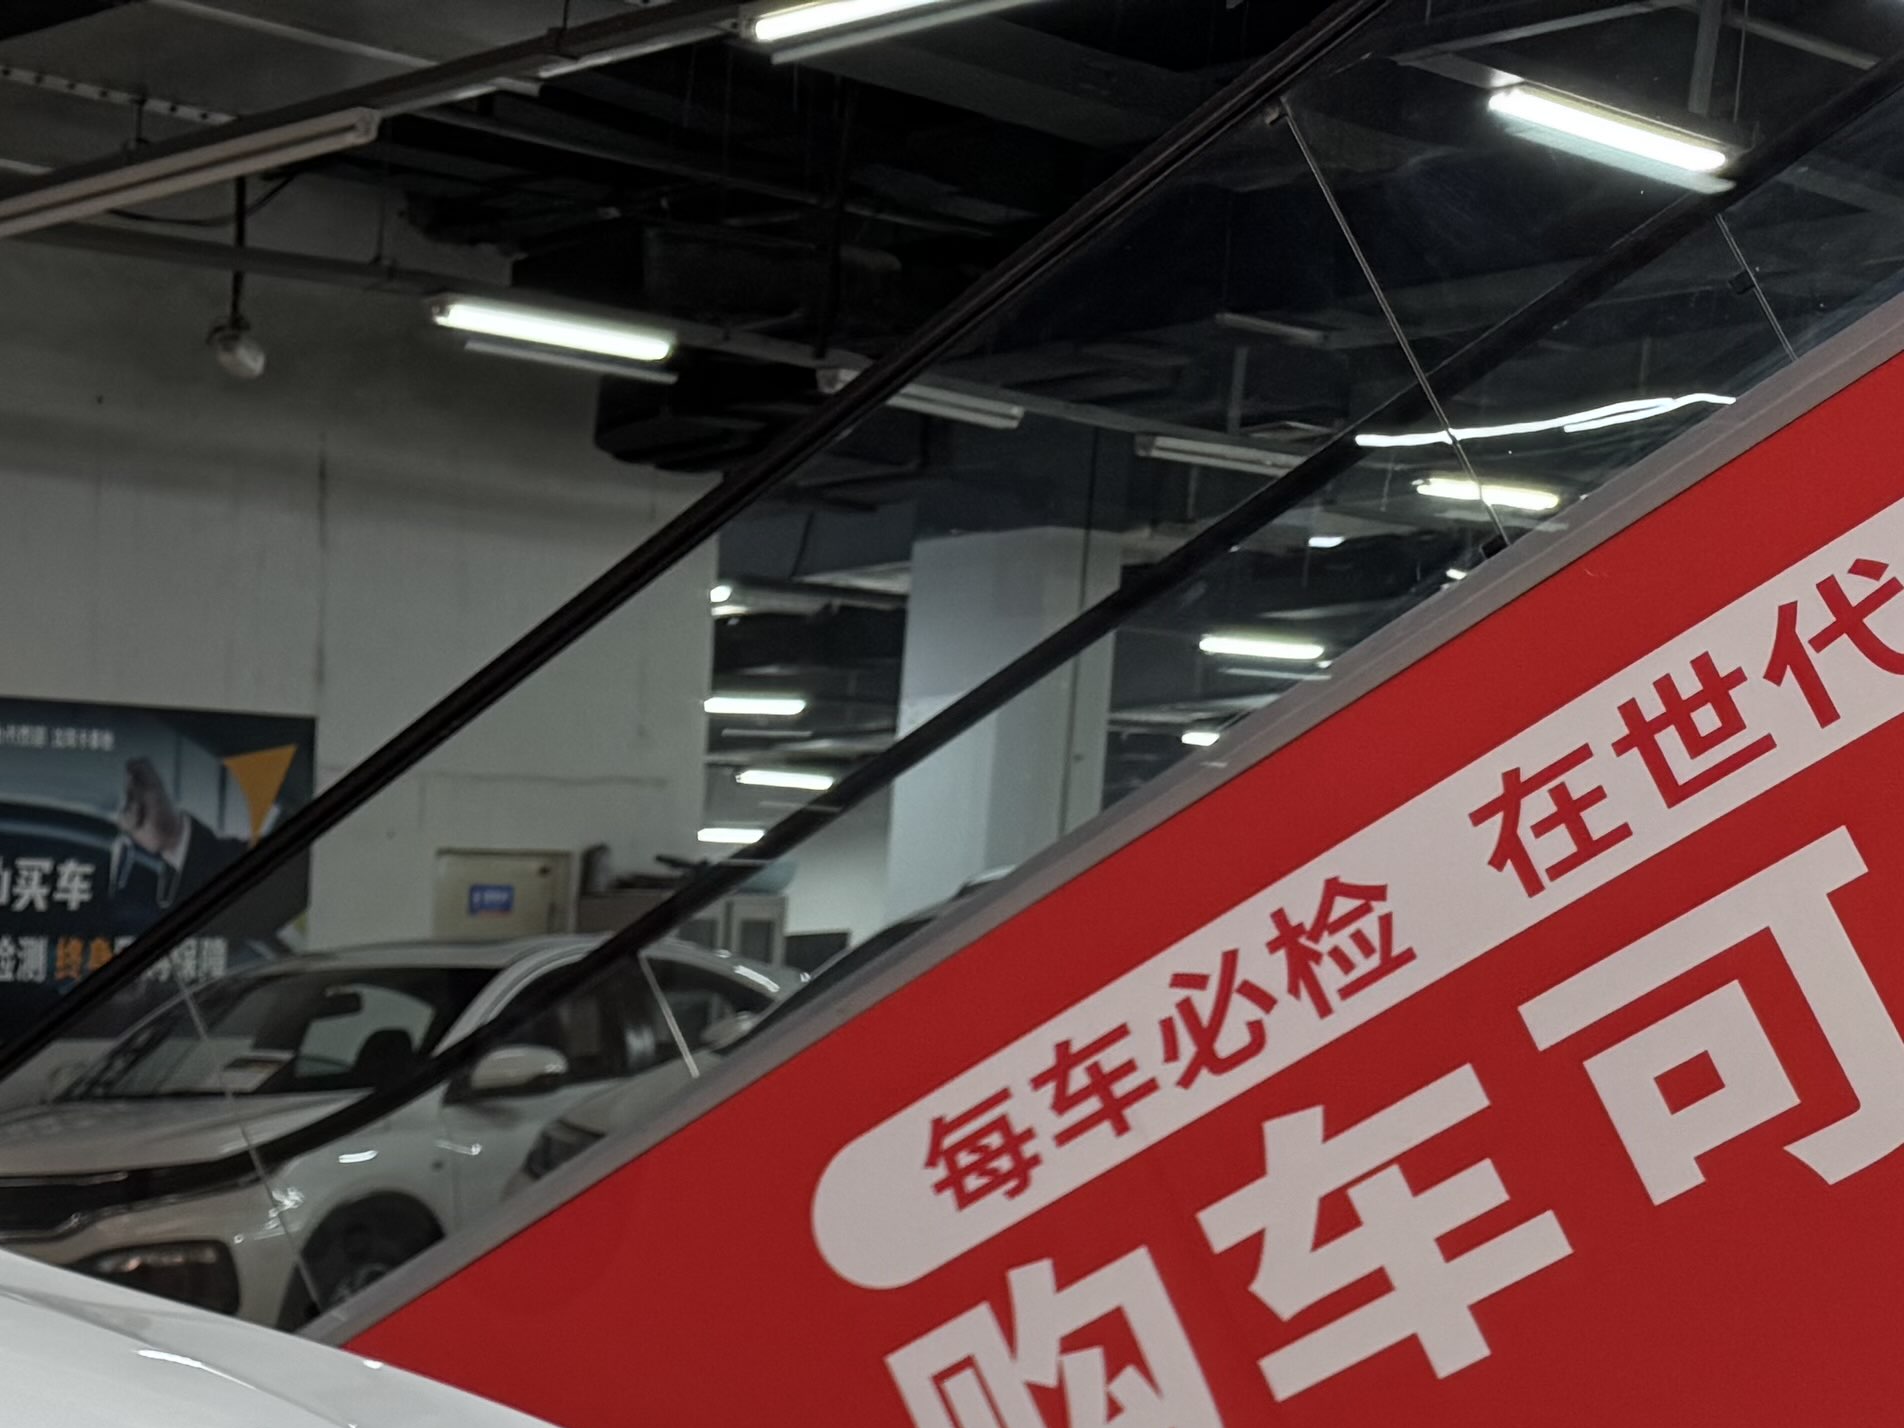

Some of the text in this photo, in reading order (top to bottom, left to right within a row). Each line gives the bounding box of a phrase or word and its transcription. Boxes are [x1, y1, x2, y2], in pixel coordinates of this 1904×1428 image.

[922, 554, 1904, 1219] 每车必检 在世代
